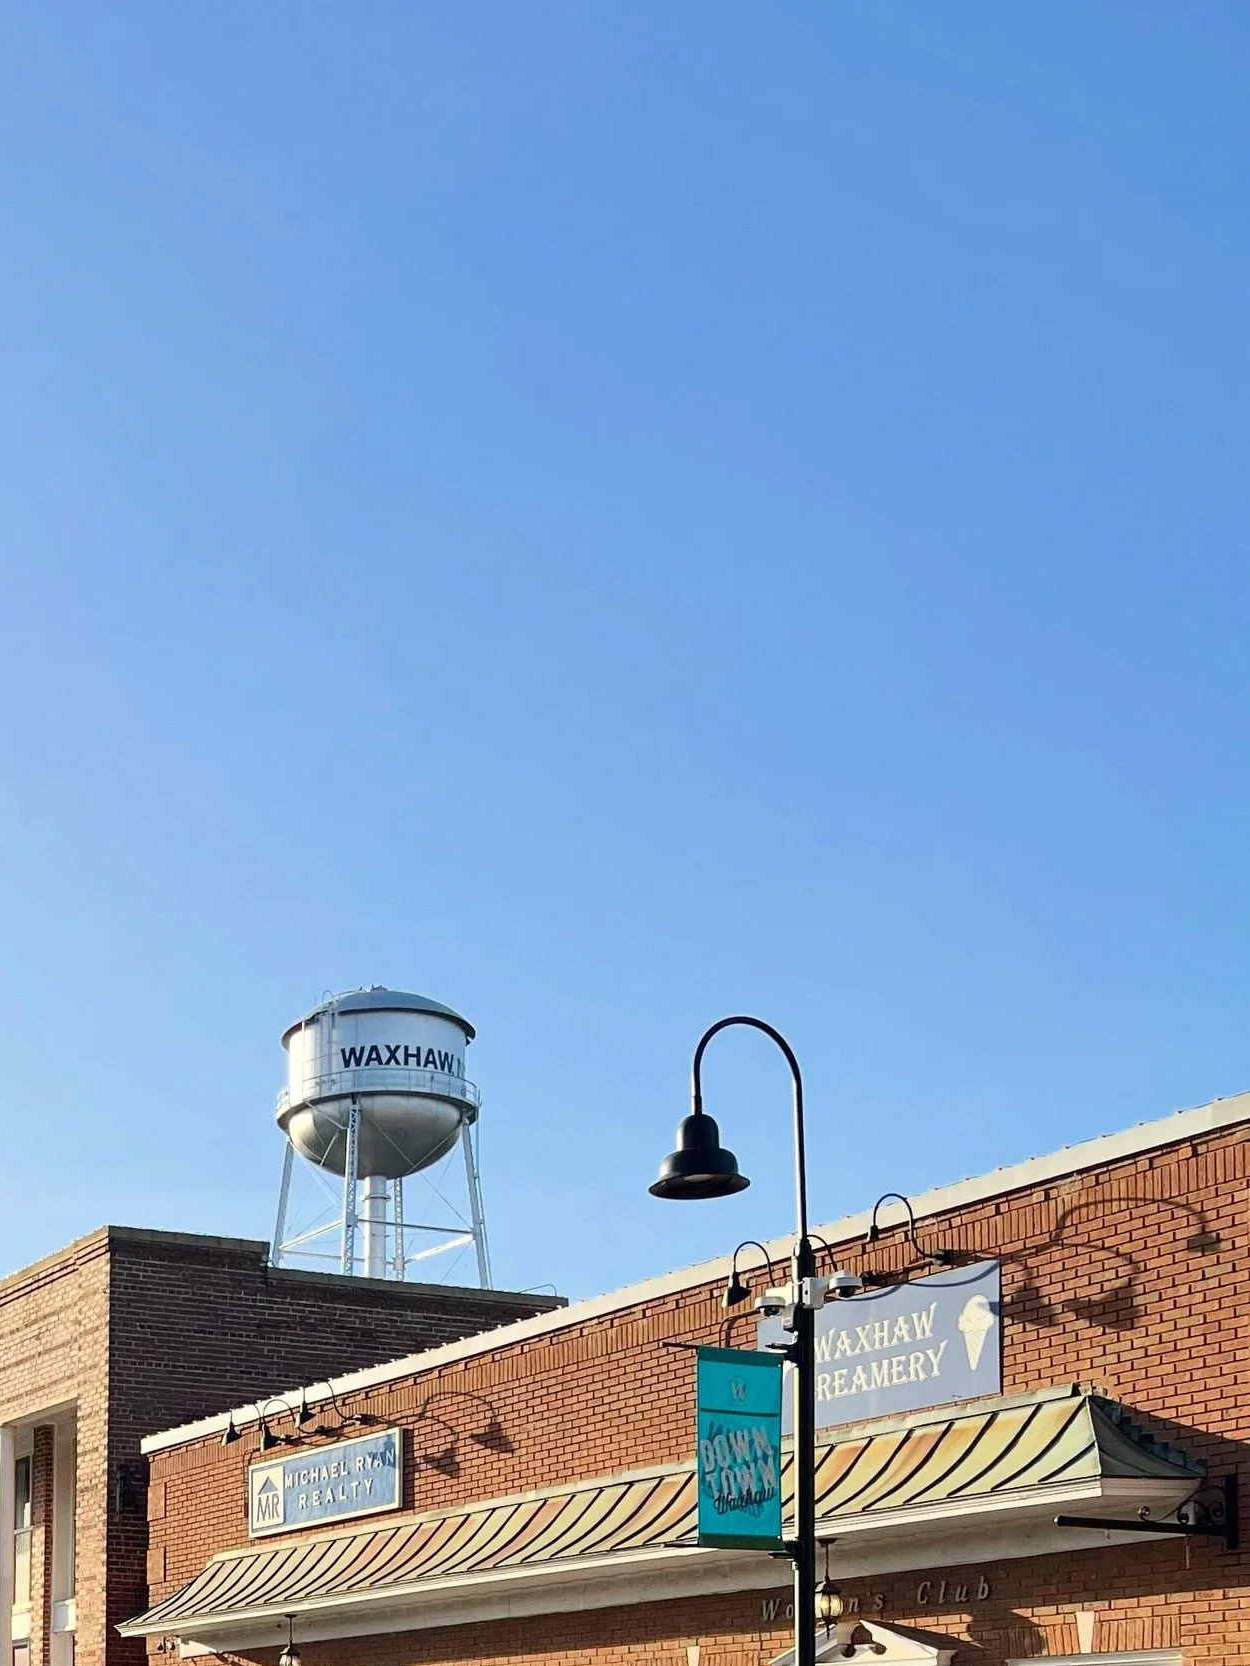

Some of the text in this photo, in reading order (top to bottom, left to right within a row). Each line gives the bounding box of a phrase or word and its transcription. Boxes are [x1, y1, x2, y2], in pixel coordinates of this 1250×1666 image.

[814, 1301, 938, 1364] WAXHAW
[814, 1339, 949, 1401] REAMERY
[284, 1448, 396, 1489] MICHAEL RYAN
[700, 1424, 774, 1473] DOWN
[298, 1478, 374, 1510] REALTY
[705, 1455, 779, 1501] TOWN
[256, 1493, 280, 1523] MR
[761, 1576, 989, 1621] Won's Club
